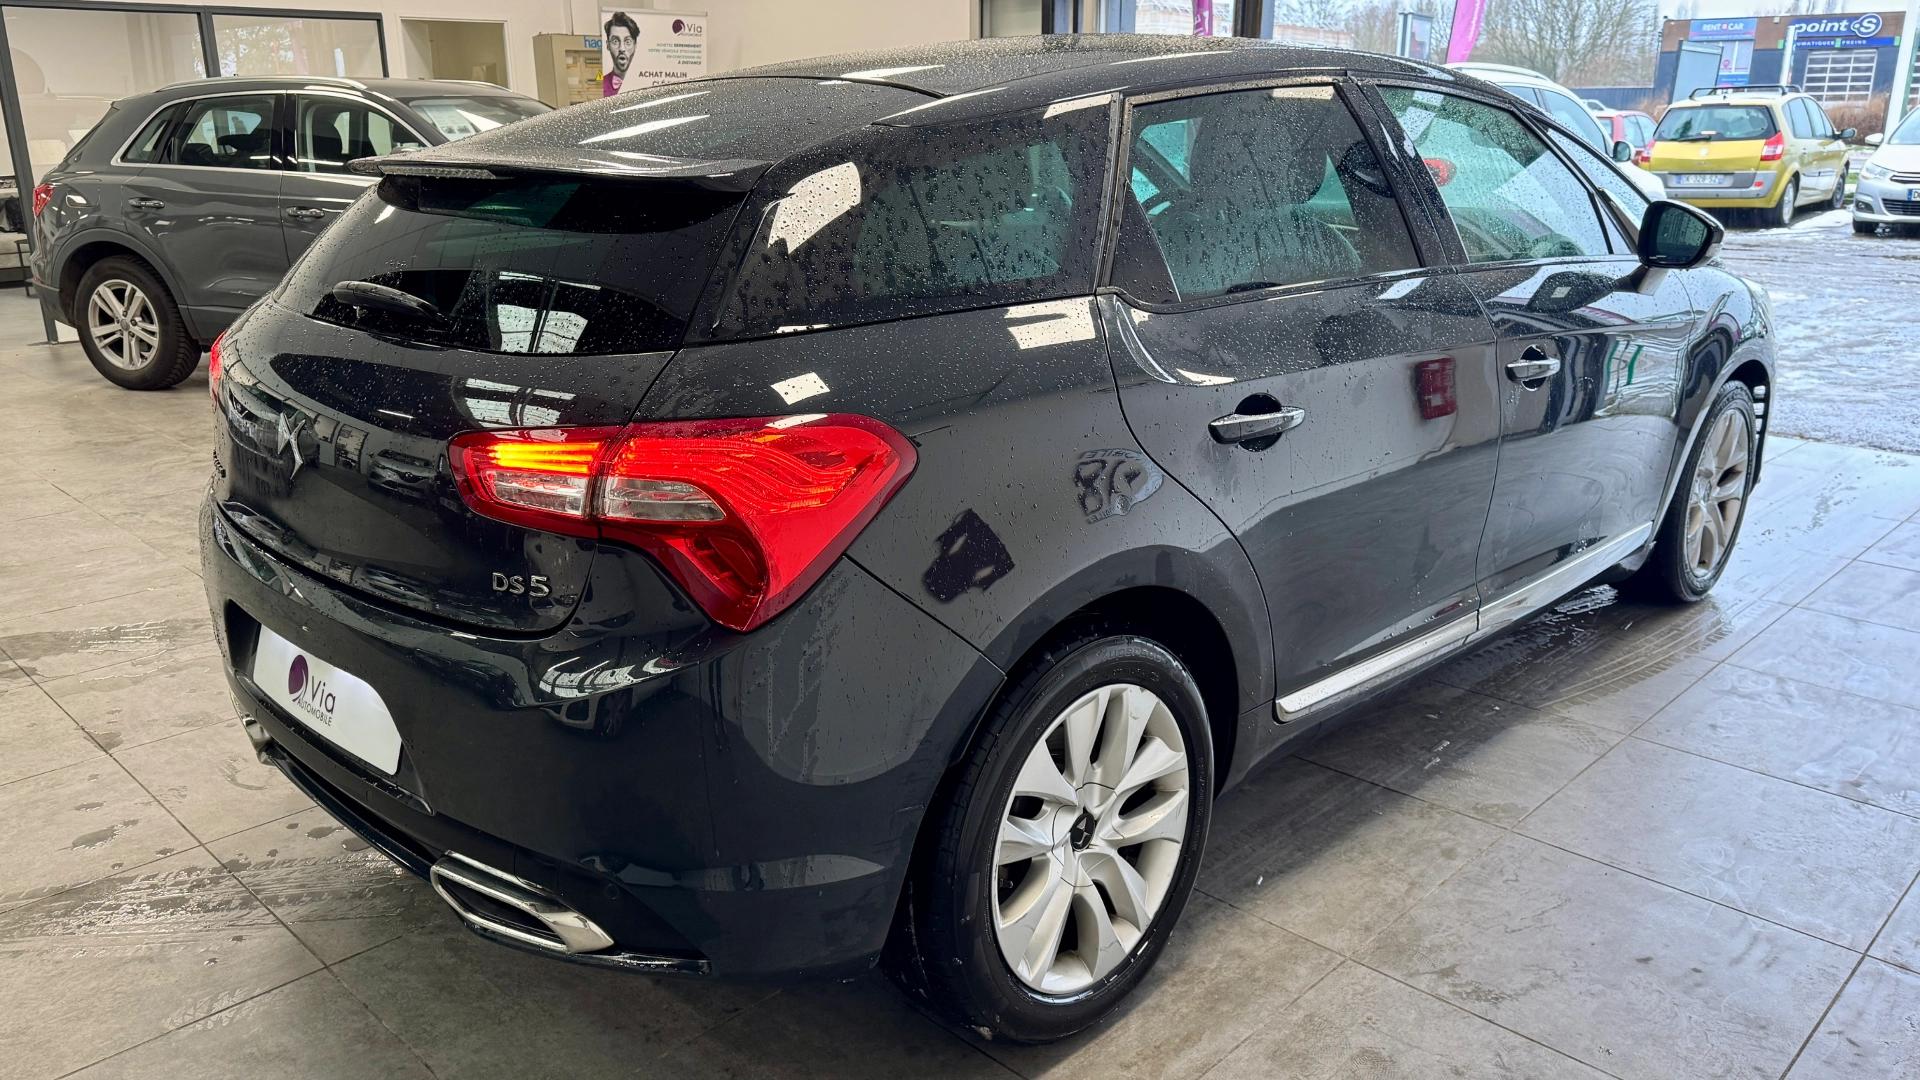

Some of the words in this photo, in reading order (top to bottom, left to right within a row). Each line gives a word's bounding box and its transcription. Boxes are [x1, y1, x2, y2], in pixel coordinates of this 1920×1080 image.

[686, 23, 703, 34] Via
[1728, 22, 1744, 30] CAR
[1795, 20, 1849, 36] point
[584, 36, 602, 49] hag
[664, 71, 688, 79] MALIN
[311, 675, 336, 714] Via
[296, 698, 333, 727] AUTOMOBILE
